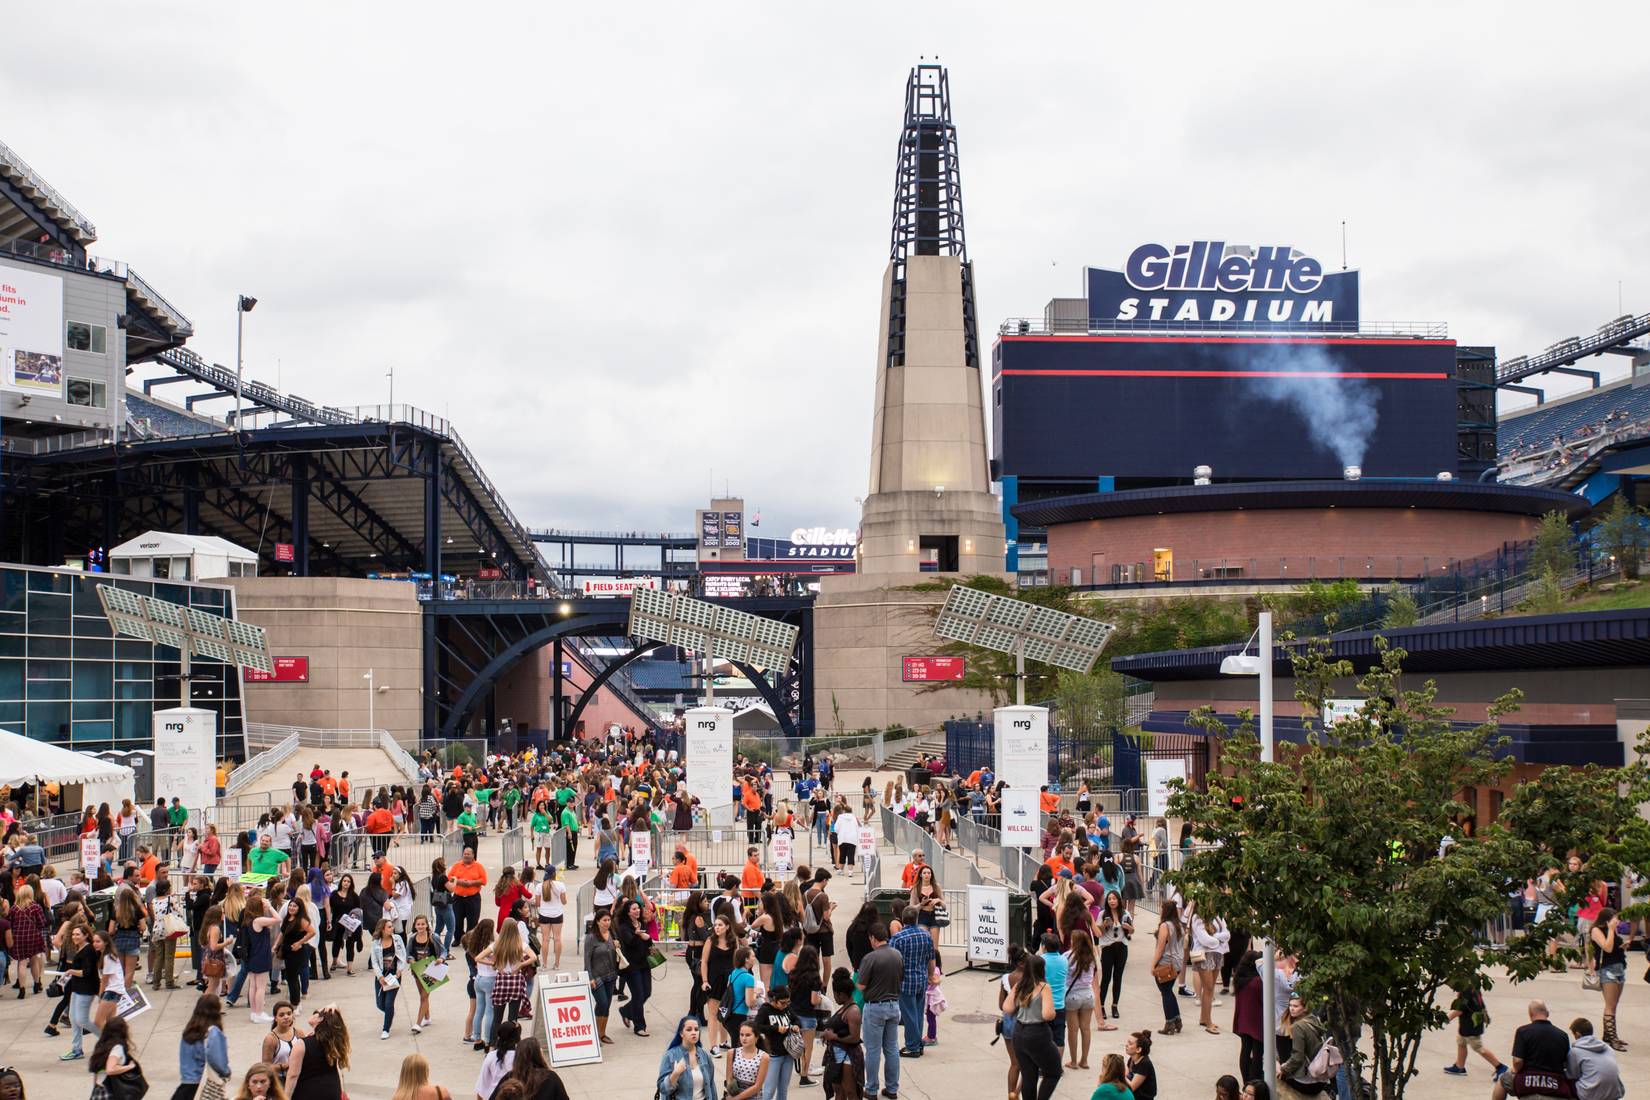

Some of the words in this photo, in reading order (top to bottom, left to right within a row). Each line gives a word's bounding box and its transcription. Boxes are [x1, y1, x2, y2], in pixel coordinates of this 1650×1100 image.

[1124, 240, 1324, 293] Gillette
[2, 284, 17, 293] fits
[17, 297, 26, 305] in
[1116, 298, 1333, 322] STADIUM
[139, 542, 160, 550] verizon
[593, 583, 613, 591] FIELD
[165, 722, 184, 733] nrg
[698, 721, 716, 732] nrg
[1013, 720, 1031, 731] nrg
[978, 914, 998, 924] WILL
[978, 925, 998, 935] CALL
[972, 936, 1004, 945] WINDOWS
[975, 946, 980, 954] 2
[994, 949, 999, 957] 7
[557, 1006, 581, 1023] NO
[552, 1024, 592, 1038] RE-ENTRY
[1525, 1075, 1559, 1089] UMASS
